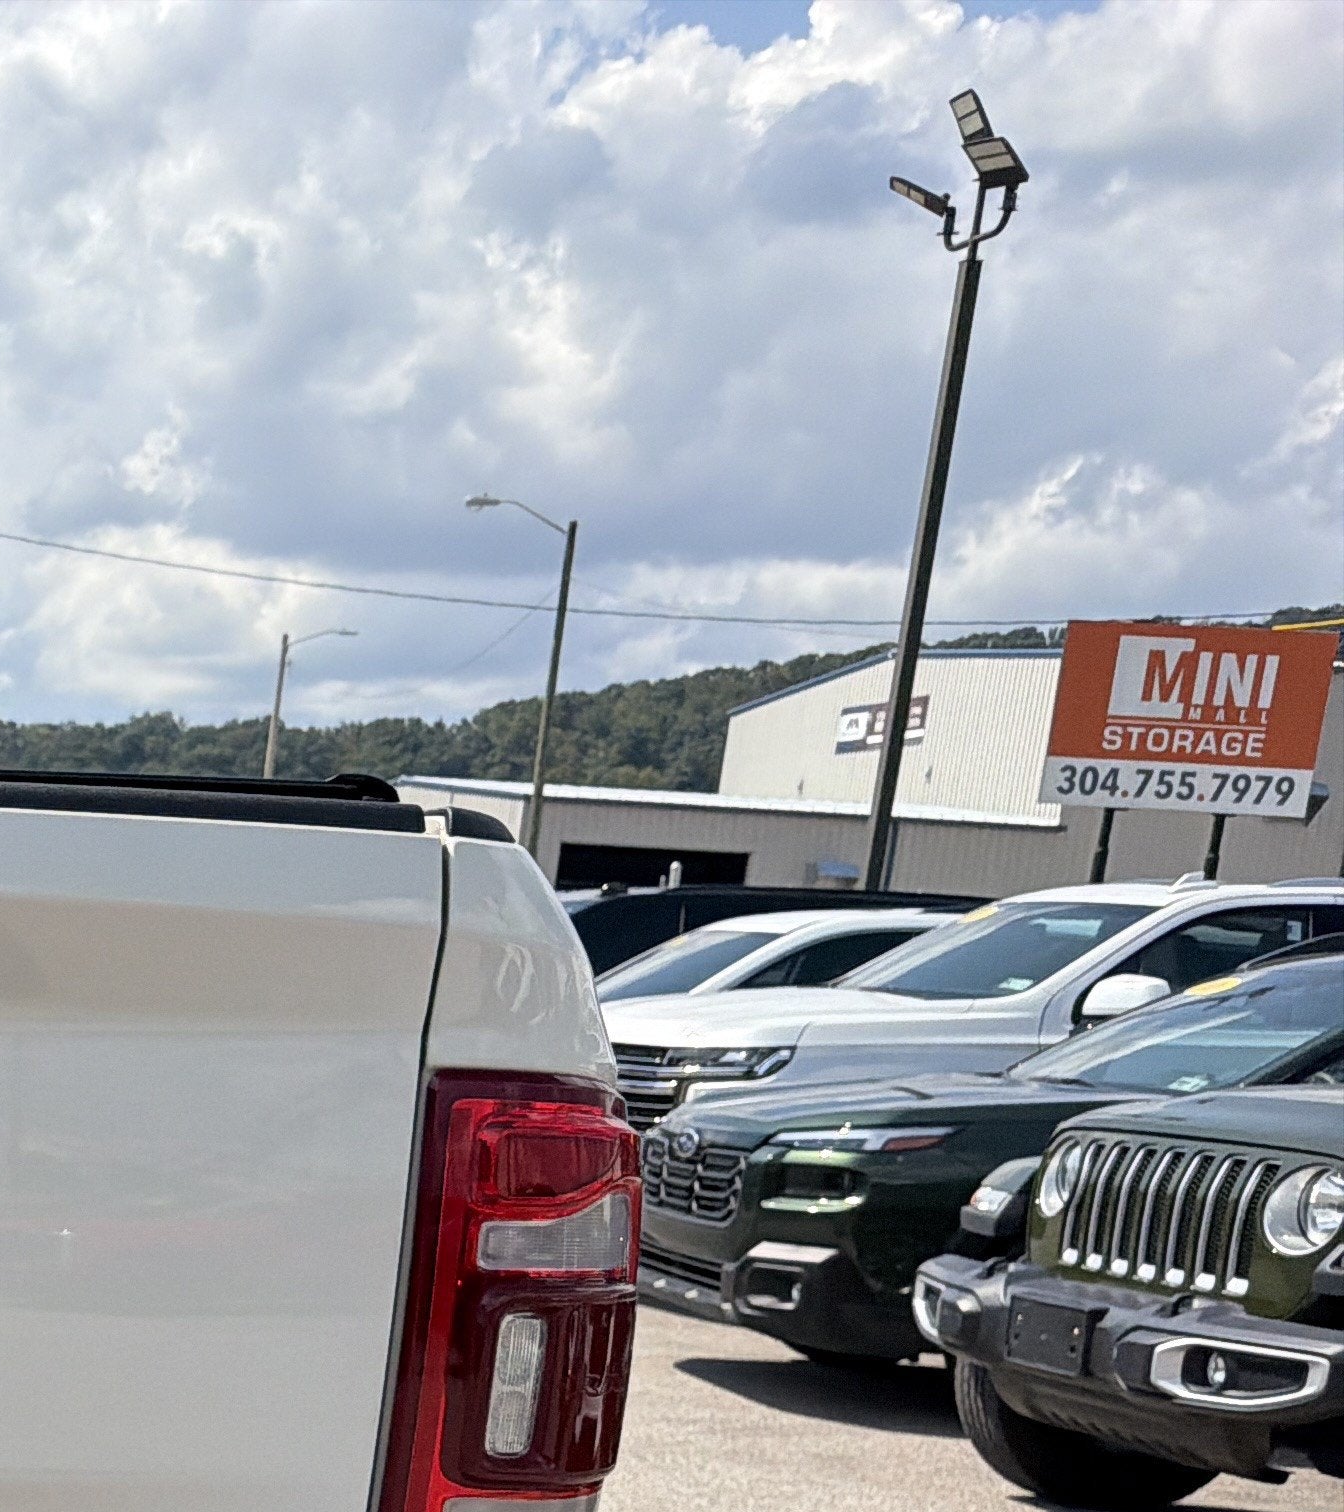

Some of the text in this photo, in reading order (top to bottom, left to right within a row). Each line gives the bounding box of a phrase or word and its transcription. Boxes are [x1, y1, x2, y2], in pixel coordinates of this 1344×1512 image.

[1138, 645, 1280, 710] MINI
[1188, 706, 1269, 725] MALL
[1102, 725, 1267, 758] STORAGE
[1056, 764, 1296, 807] 304.755.7979
